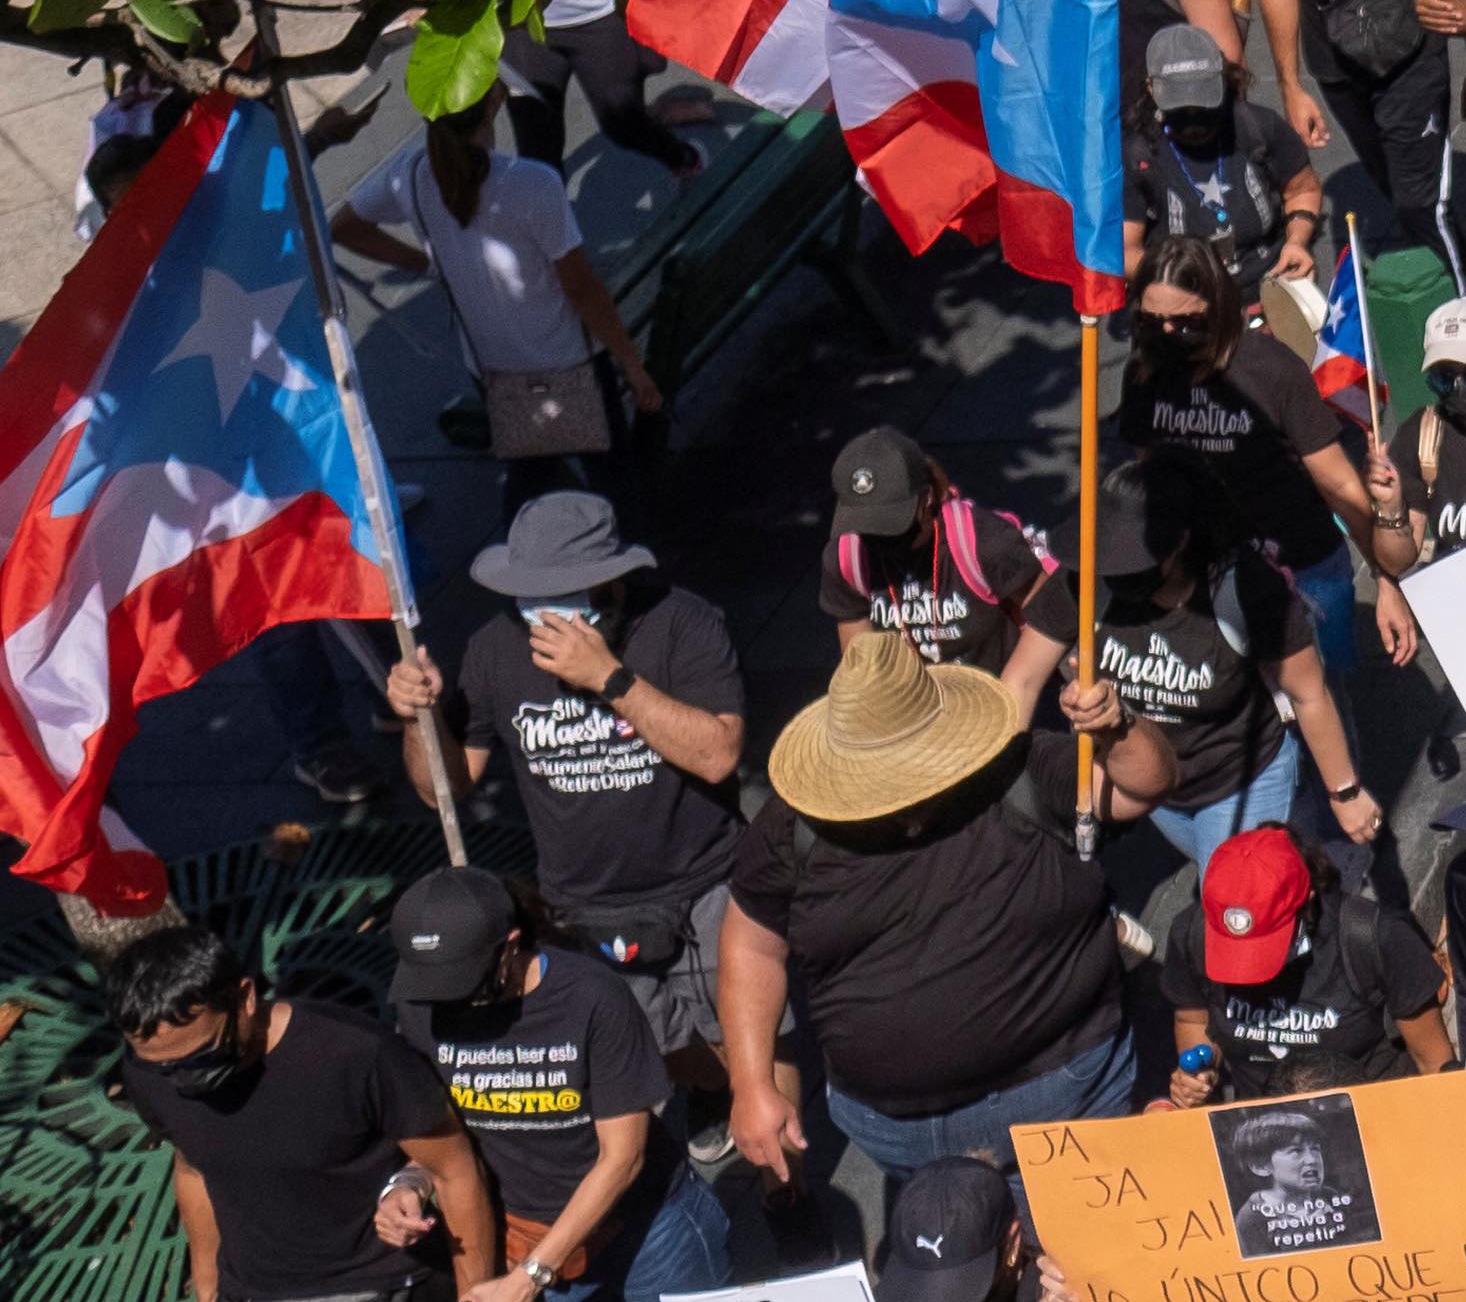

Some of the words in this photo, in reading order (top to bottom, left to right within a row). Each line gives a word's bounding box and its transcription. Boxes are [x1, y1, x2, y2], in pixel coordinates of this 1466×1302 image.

[1148, 632, 1169, 654] SIN
[1100, 636, 1213, 694] Maestros
[438, 1044, 454, 1064] Si
[456, 1043, 512, 1069] puedes
[515, 1044, 544, 1066] leer
[473, 1069, 531, 1092] gracias
[548, 1070, 567, 1086] un
[451, 1086, 581, 1114] MAESTR@
[1024, 1128, 1090, 1166] JA
[1074, 1167, 1147, 1208] JA
[1302, 1196, 1325, 1211] no
[1331, 1195, 1351, 1206] se
[1137, 1201, 1225, 1251] JA!
[1349, 1251, 1441, 1300] QUE
